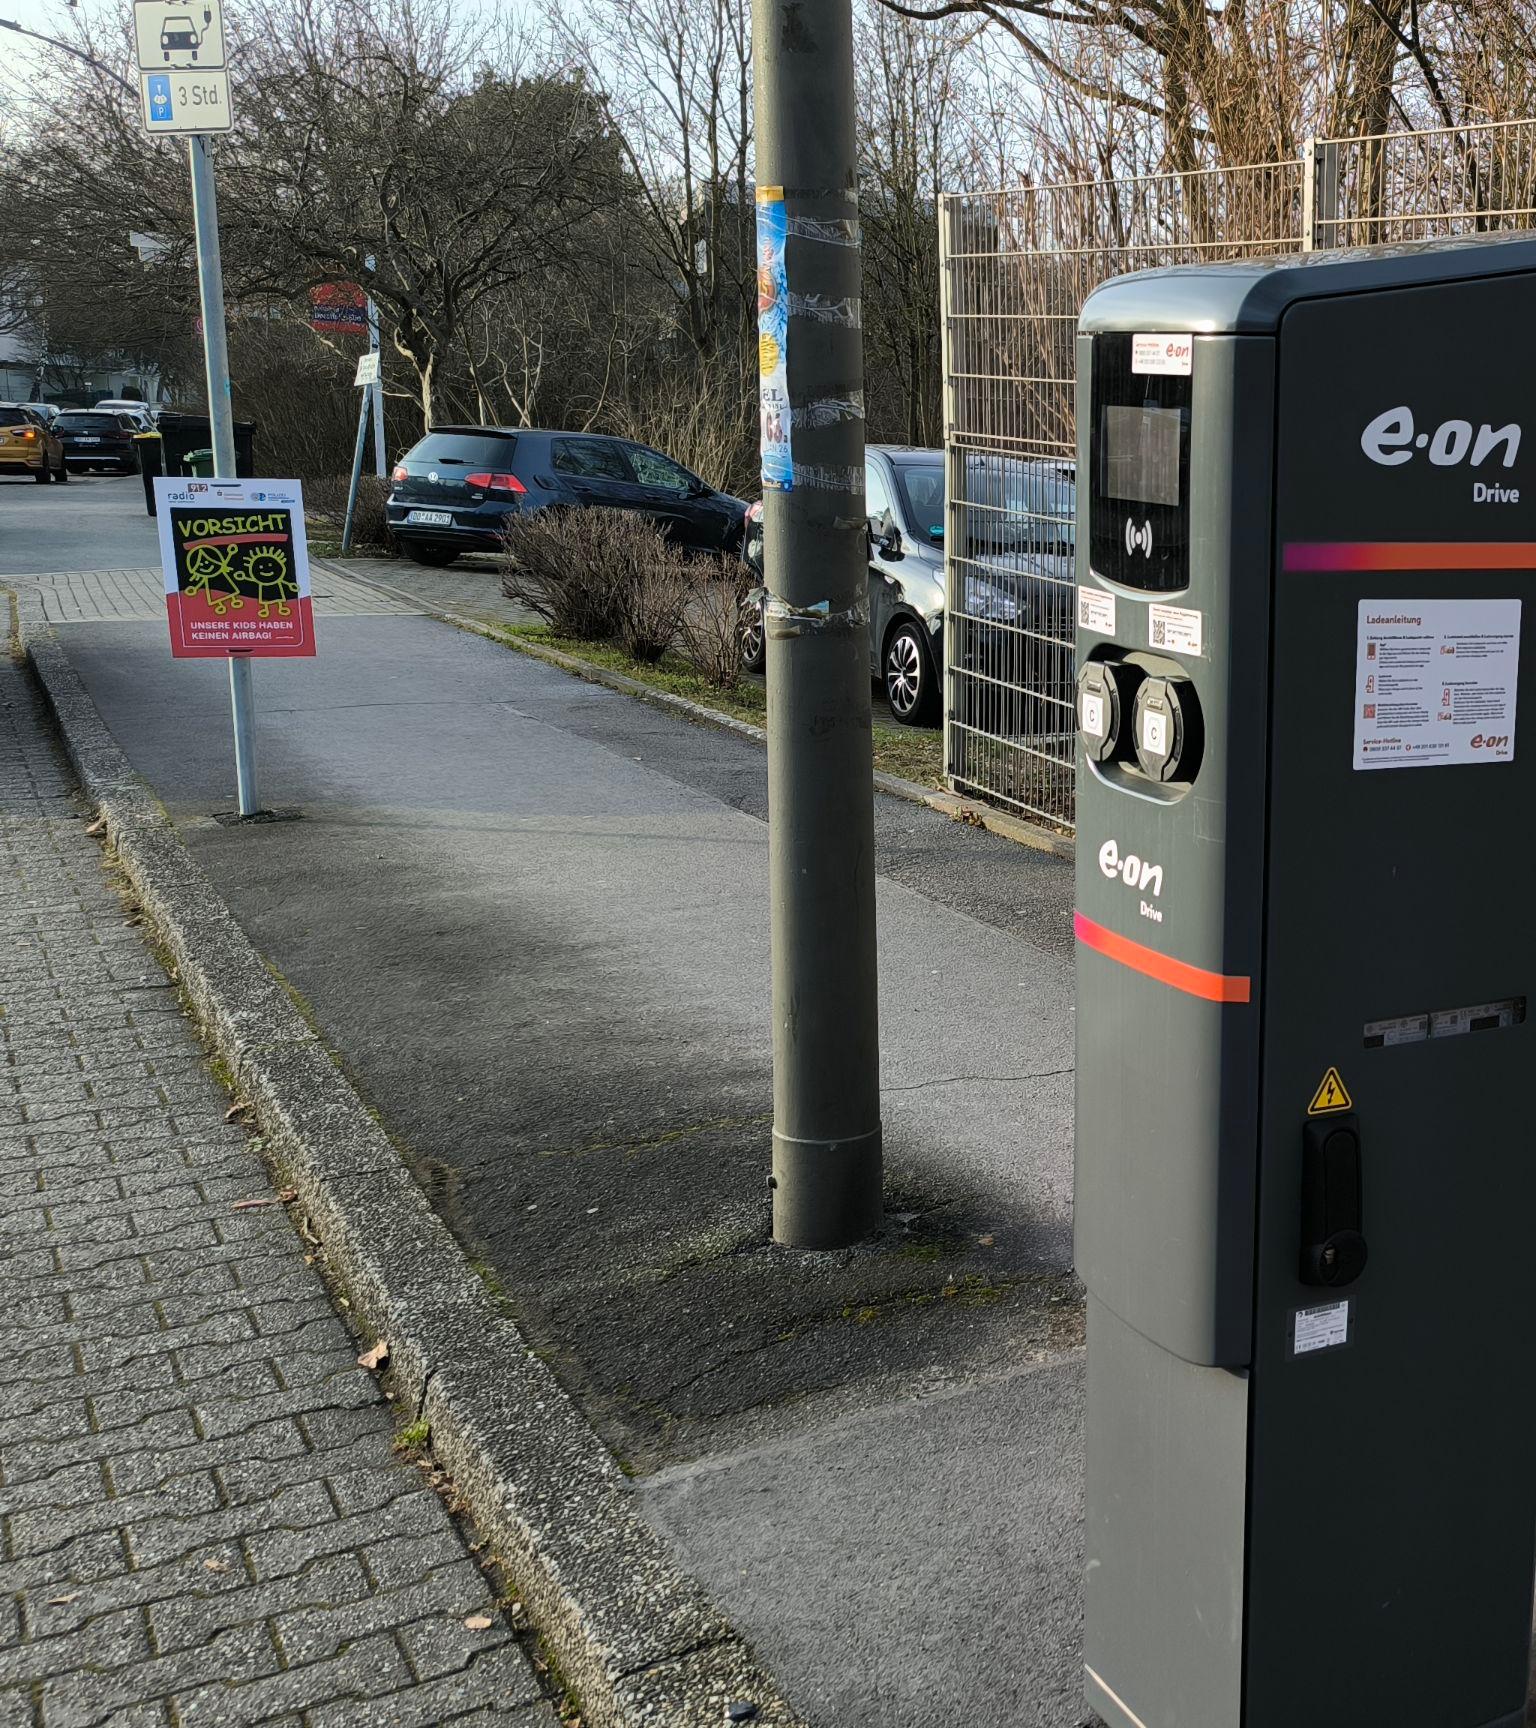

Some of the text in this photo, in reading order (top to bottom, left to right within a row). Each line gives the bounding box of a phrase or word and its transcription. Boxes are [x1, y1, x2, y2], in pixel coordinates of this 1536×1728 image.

[178, 84, 222, 106] 3 Std.
[167, 491, 195, 501] radio
[1473, 483, 1520, 503] Drive
[178, 514, 287, 538] VORSICHT
[190, 621, 293, 630] UNSERE KIDS HABEN
[1366, 615, 1422, 626] Ladeanleitung
[191, 631, 272, 640] KEINEN AIRBAG!
[1089, 709, 1095, 722] C
[1151, 727, 1157, 740] C
[1140, 901, 1163, 922] Drive
